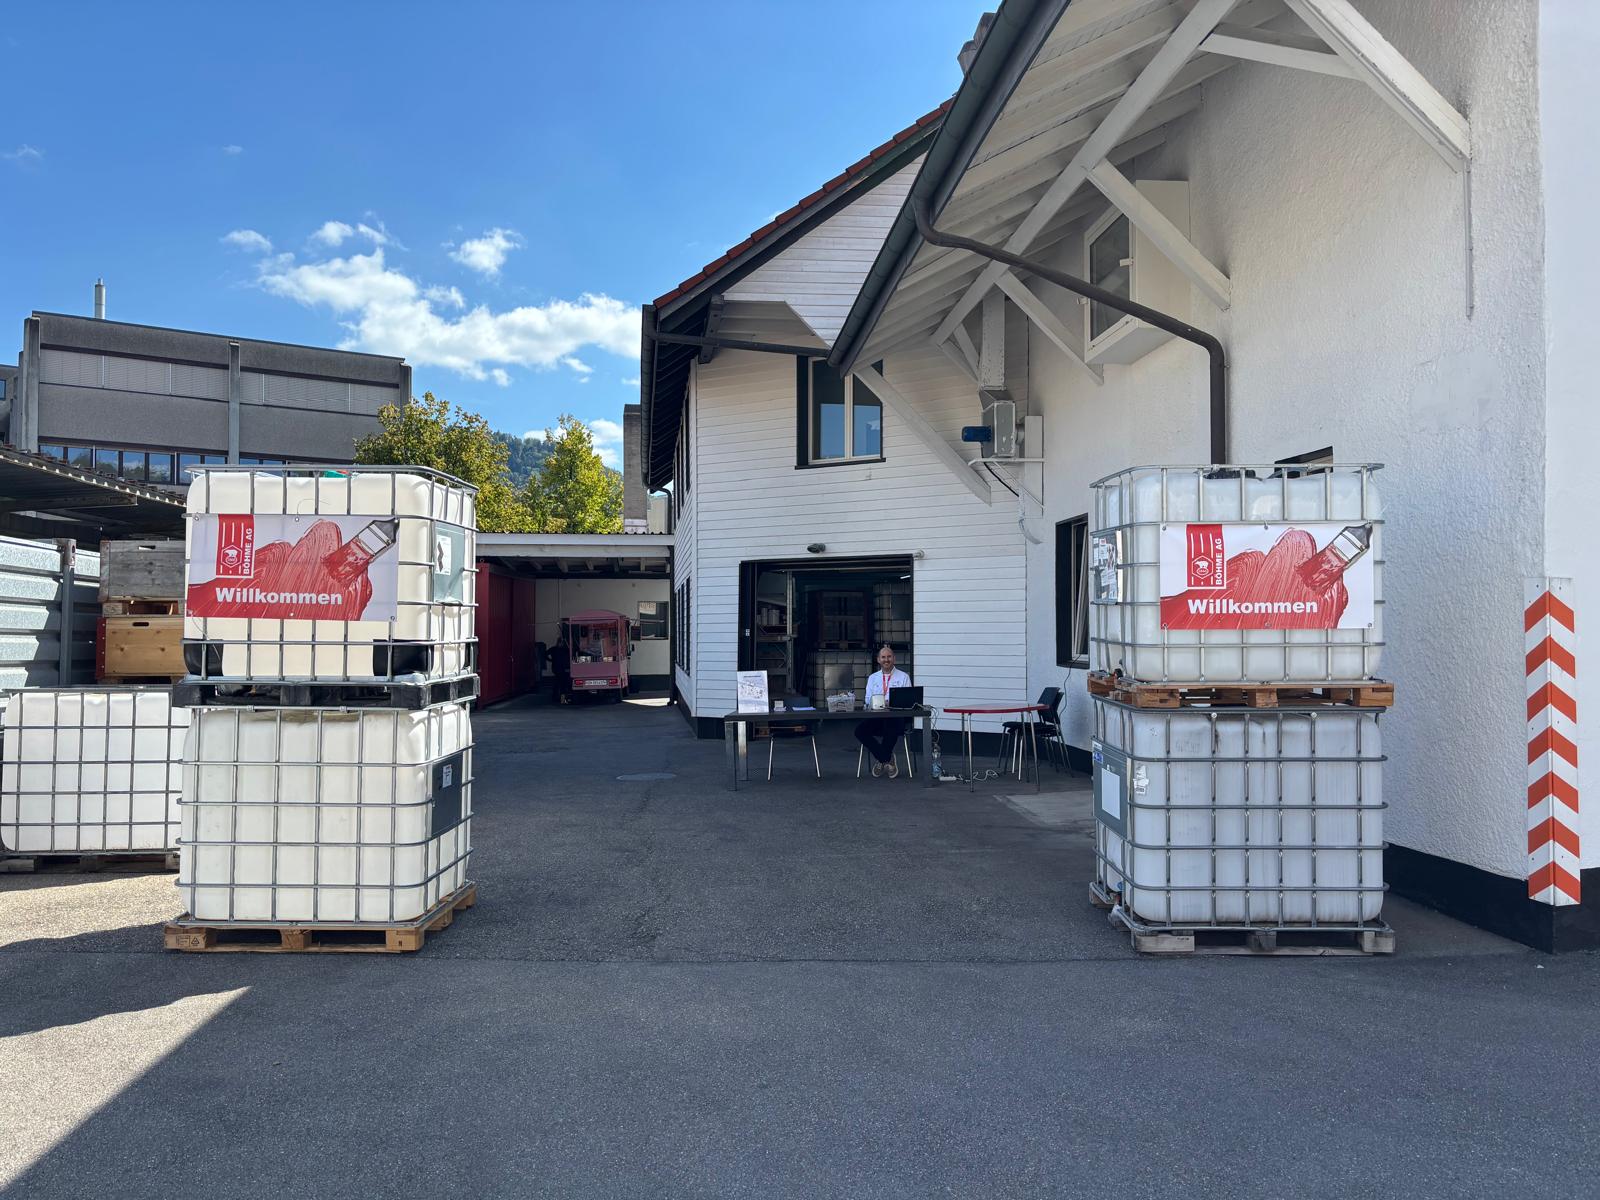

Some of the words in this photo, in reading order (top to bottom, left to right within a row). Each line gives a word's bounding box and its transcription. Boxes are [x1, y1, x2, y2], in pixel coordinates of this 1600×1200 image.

[245, 528, 253, 541] AG
[1215, 538, 1223, 551] AG
[243, 542, 252, 575] BÖHME
[1214, 552, 1223, 585] BÖHME
[215, 587, 343, 605] Willkommen
[1187, 599, 1318, 614] Willkommen
